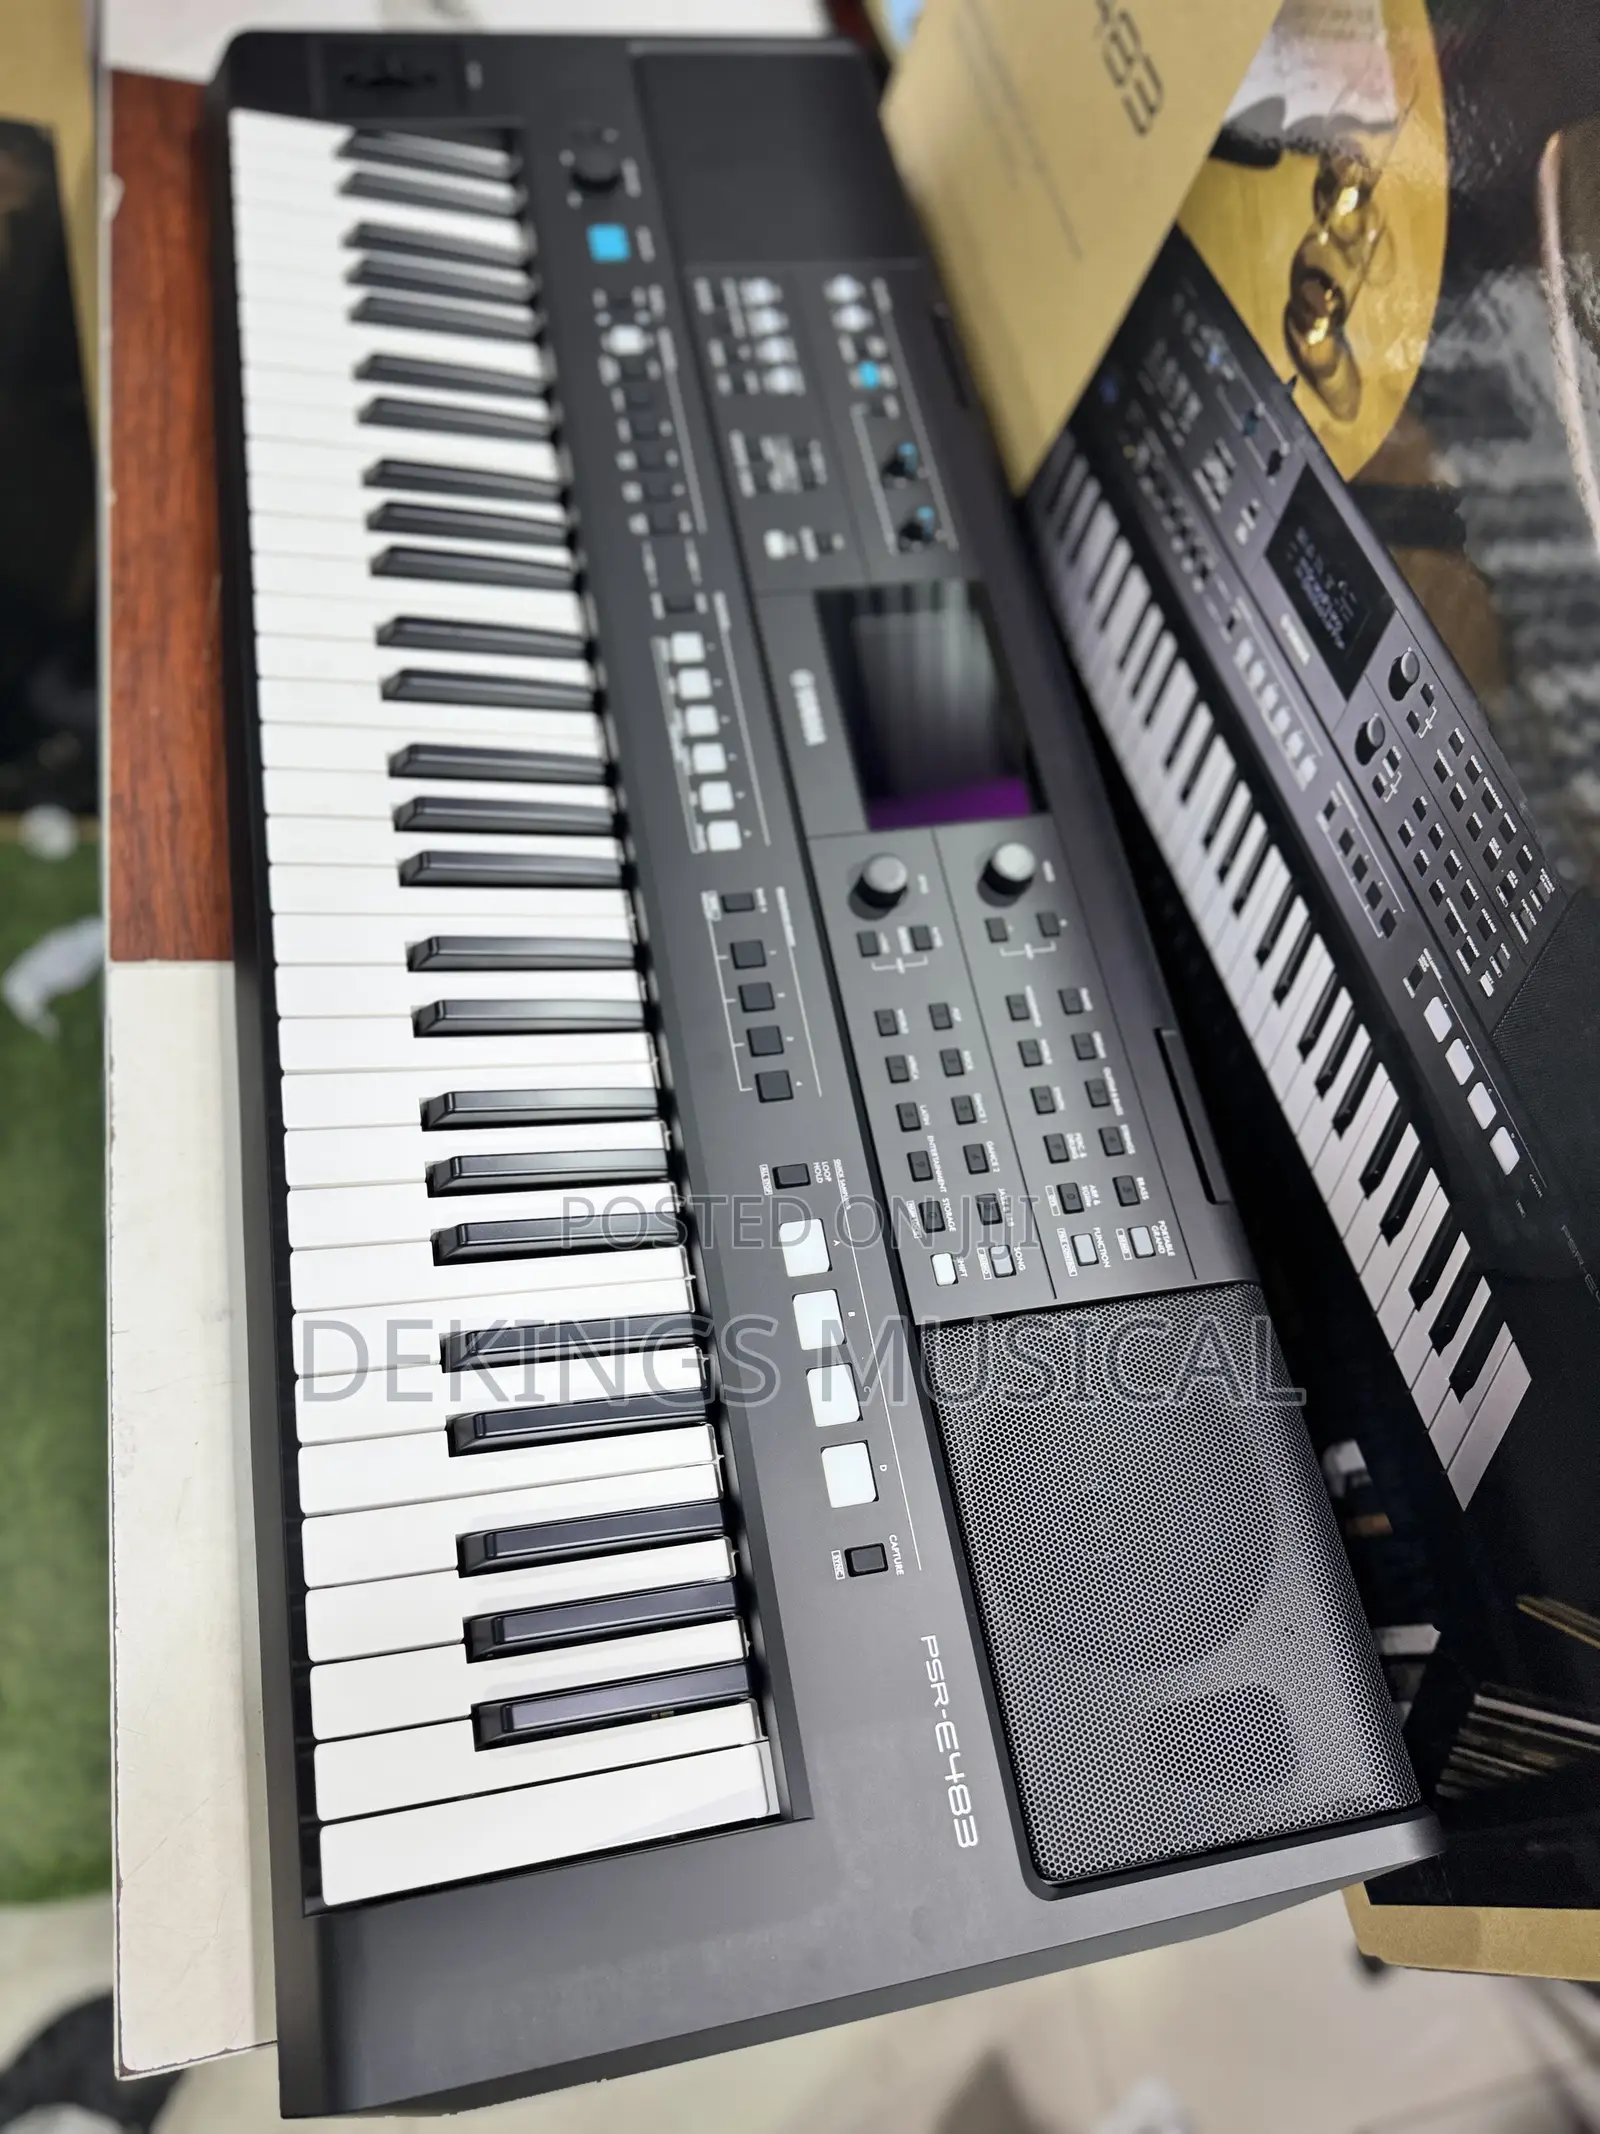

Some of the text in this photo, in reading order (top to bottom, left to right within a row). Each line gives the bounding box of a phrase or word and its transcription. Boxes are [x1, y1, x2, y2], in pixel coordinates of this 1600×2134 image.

[920, 1105, 931, 1126] LATIN
[927, 1135, 947, 1193] ENTERTAINMENT
[986, 1140, 999, 1167] DANCE
[813, 1161, 823, 1183] HOLD
[821, 1161, 832, 1182] LOOP
[1136, 1177, 1149, 1201] BRASS
[942, 1197, 956, 1232] STORAGE
[833, 1239, 840, 1247] A
[1093, 1226, 1112, 1268] FUNCTION
[1150, 1225, 1165, 1254] GRAND
[1157, 1219, 1176, 1257] PORTABLE
[956, 1257, 969, 1278] SHIFT
[1013, 1246, 1026, 1271] SONG
[863, 1385, 872, 1394] C
[879, 1464, 888, 1472] D
[832, 1553, 844, 1577] SYNC
[889, 1534, 904, 1577] CAPTURE
[920, 1633, 979, 1849] PSR-E483
